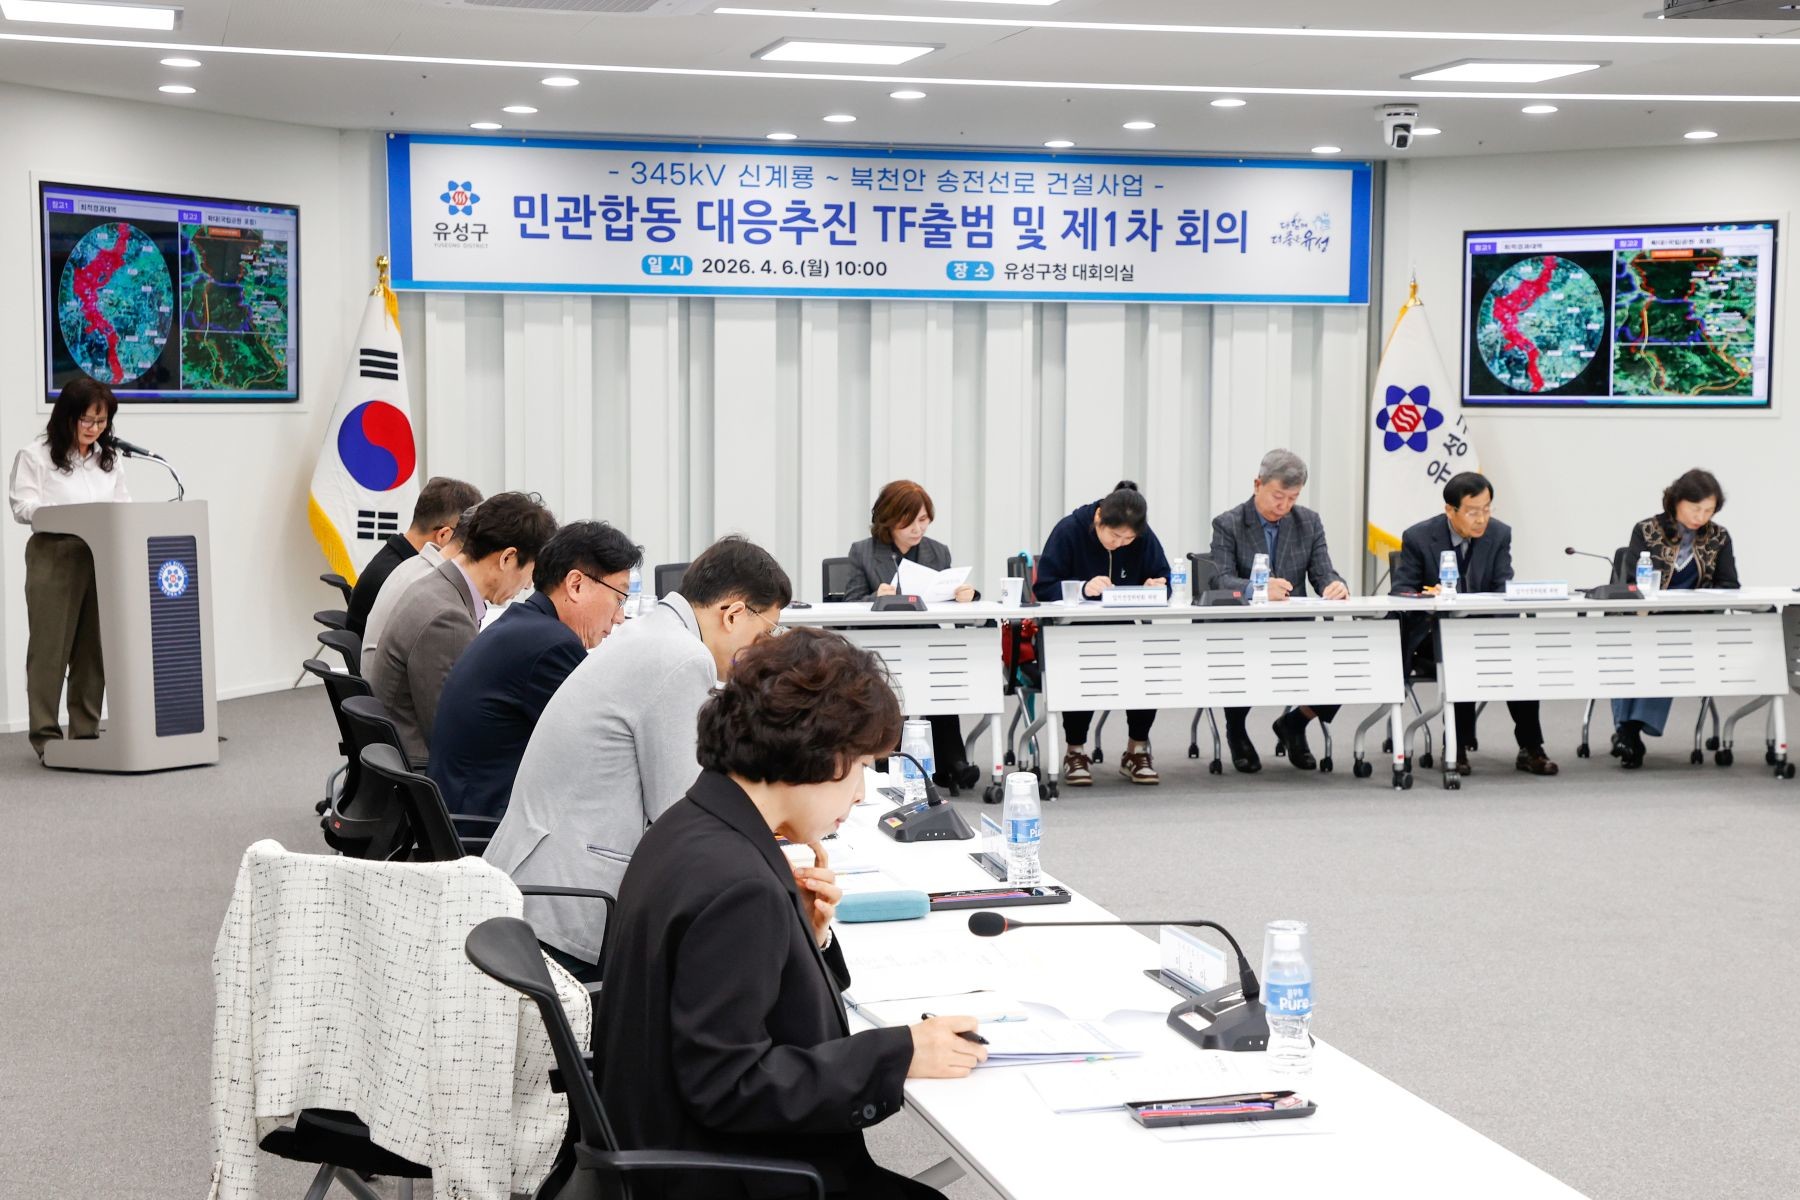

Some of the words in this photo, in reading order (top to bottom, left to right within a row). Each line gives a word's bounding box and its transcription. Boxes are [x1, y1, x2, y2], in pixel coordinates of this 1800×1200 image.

[630, 161, 726, 187] 345kV
[738, 164, 815, 190] 신계룡
[850, 166, 926, 193] 북천안
[936, 168, 1036, 195] 송전선로
[1047, 171, 1143, 197] 건설사업
[433, 222, 489, 242] 유성구
[513, 193, 682, 243] 민관합동
[696, 198, 857, 246] 대응추진
[872, 203, 994, 249] TF출범
[1013, 205, 1047, 251] 및
[1060, 207, 1164, 253] 제1차
[1175, 208, 1248, 253] 회의
[702, 258, 755, 274] 2026.
[760, 259, 776, 274] 4.
[835, 260, 888, 276] 10:00
[1004, 263, 1067, 281] 유성구청
[1072, 263, 1134, 282] 대회의실
[1280, 997, 1310, 1011] Pure
